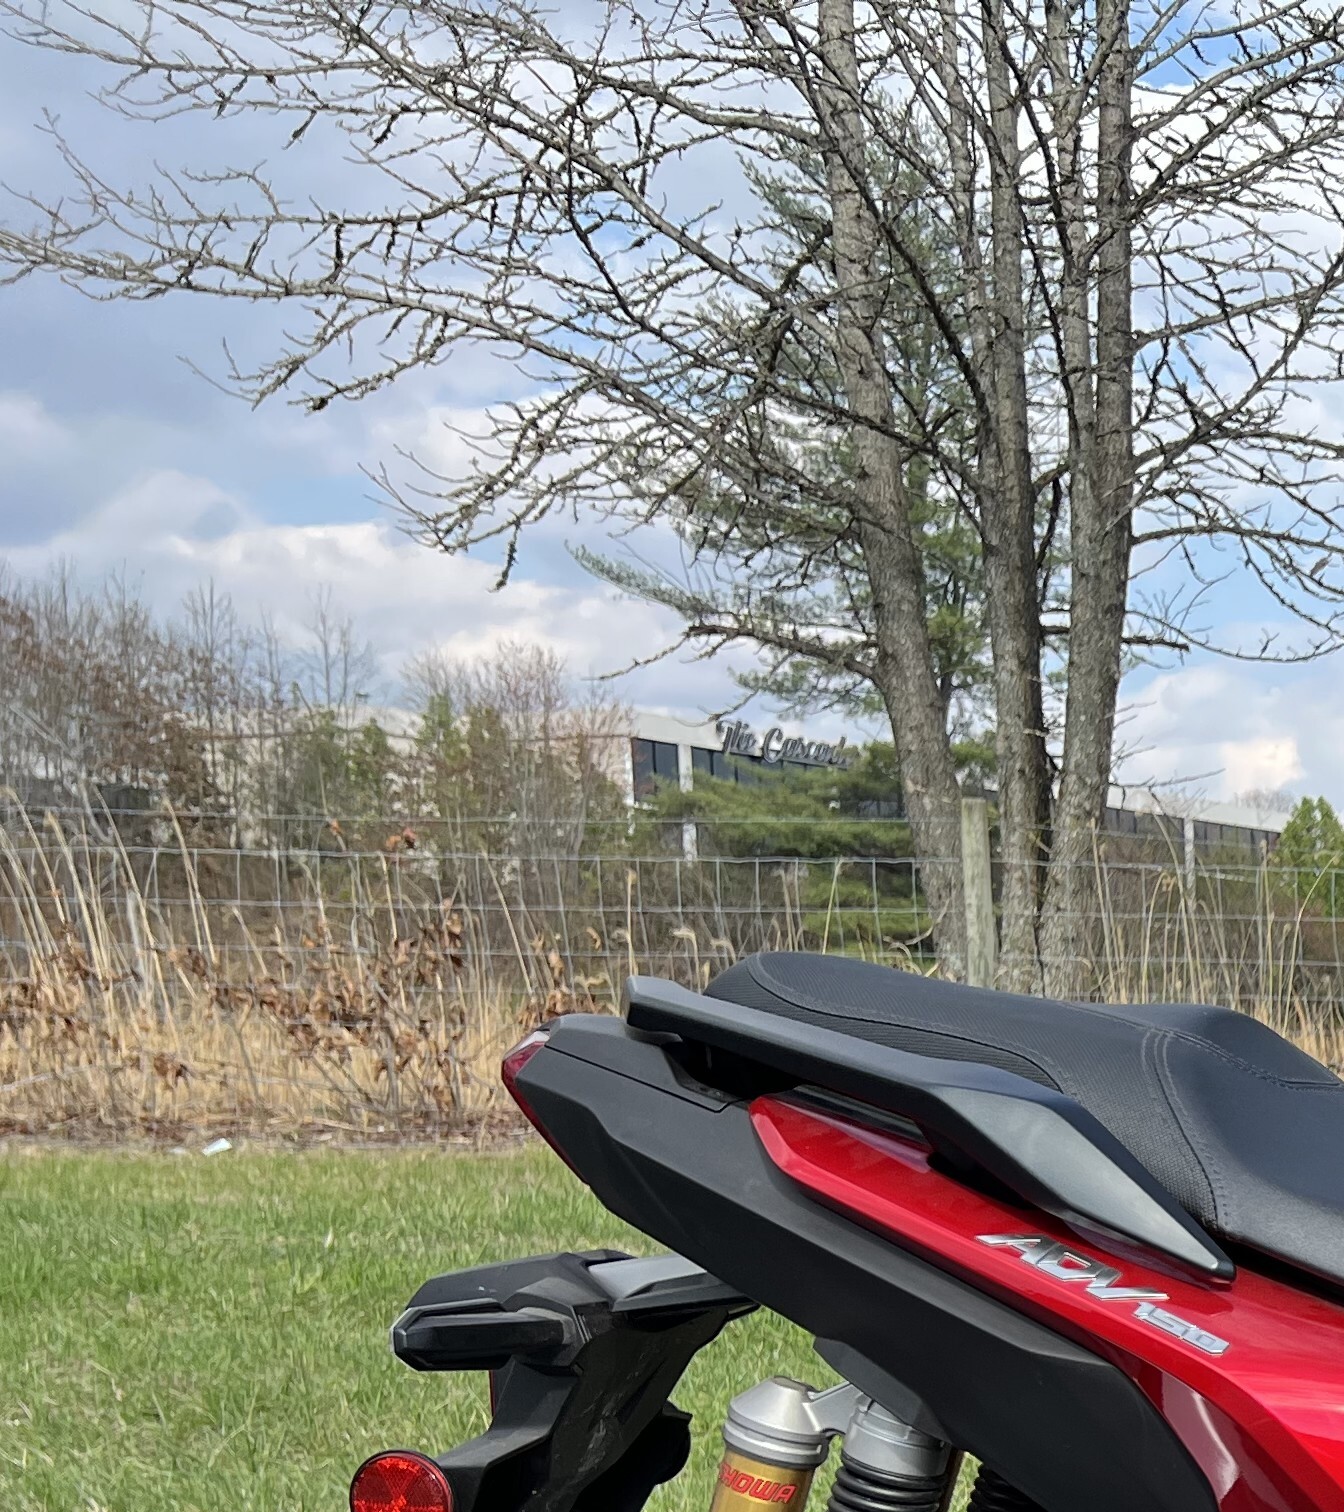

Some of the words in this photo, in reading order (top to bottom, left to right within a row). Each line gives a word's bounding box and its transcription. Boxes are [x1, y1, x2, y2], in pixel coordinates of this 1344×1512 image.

[716, 720, 758, 752] The
[974, 1232, 1170, 1301] ADV
[1132, 1301, 1231, 1356] 150
